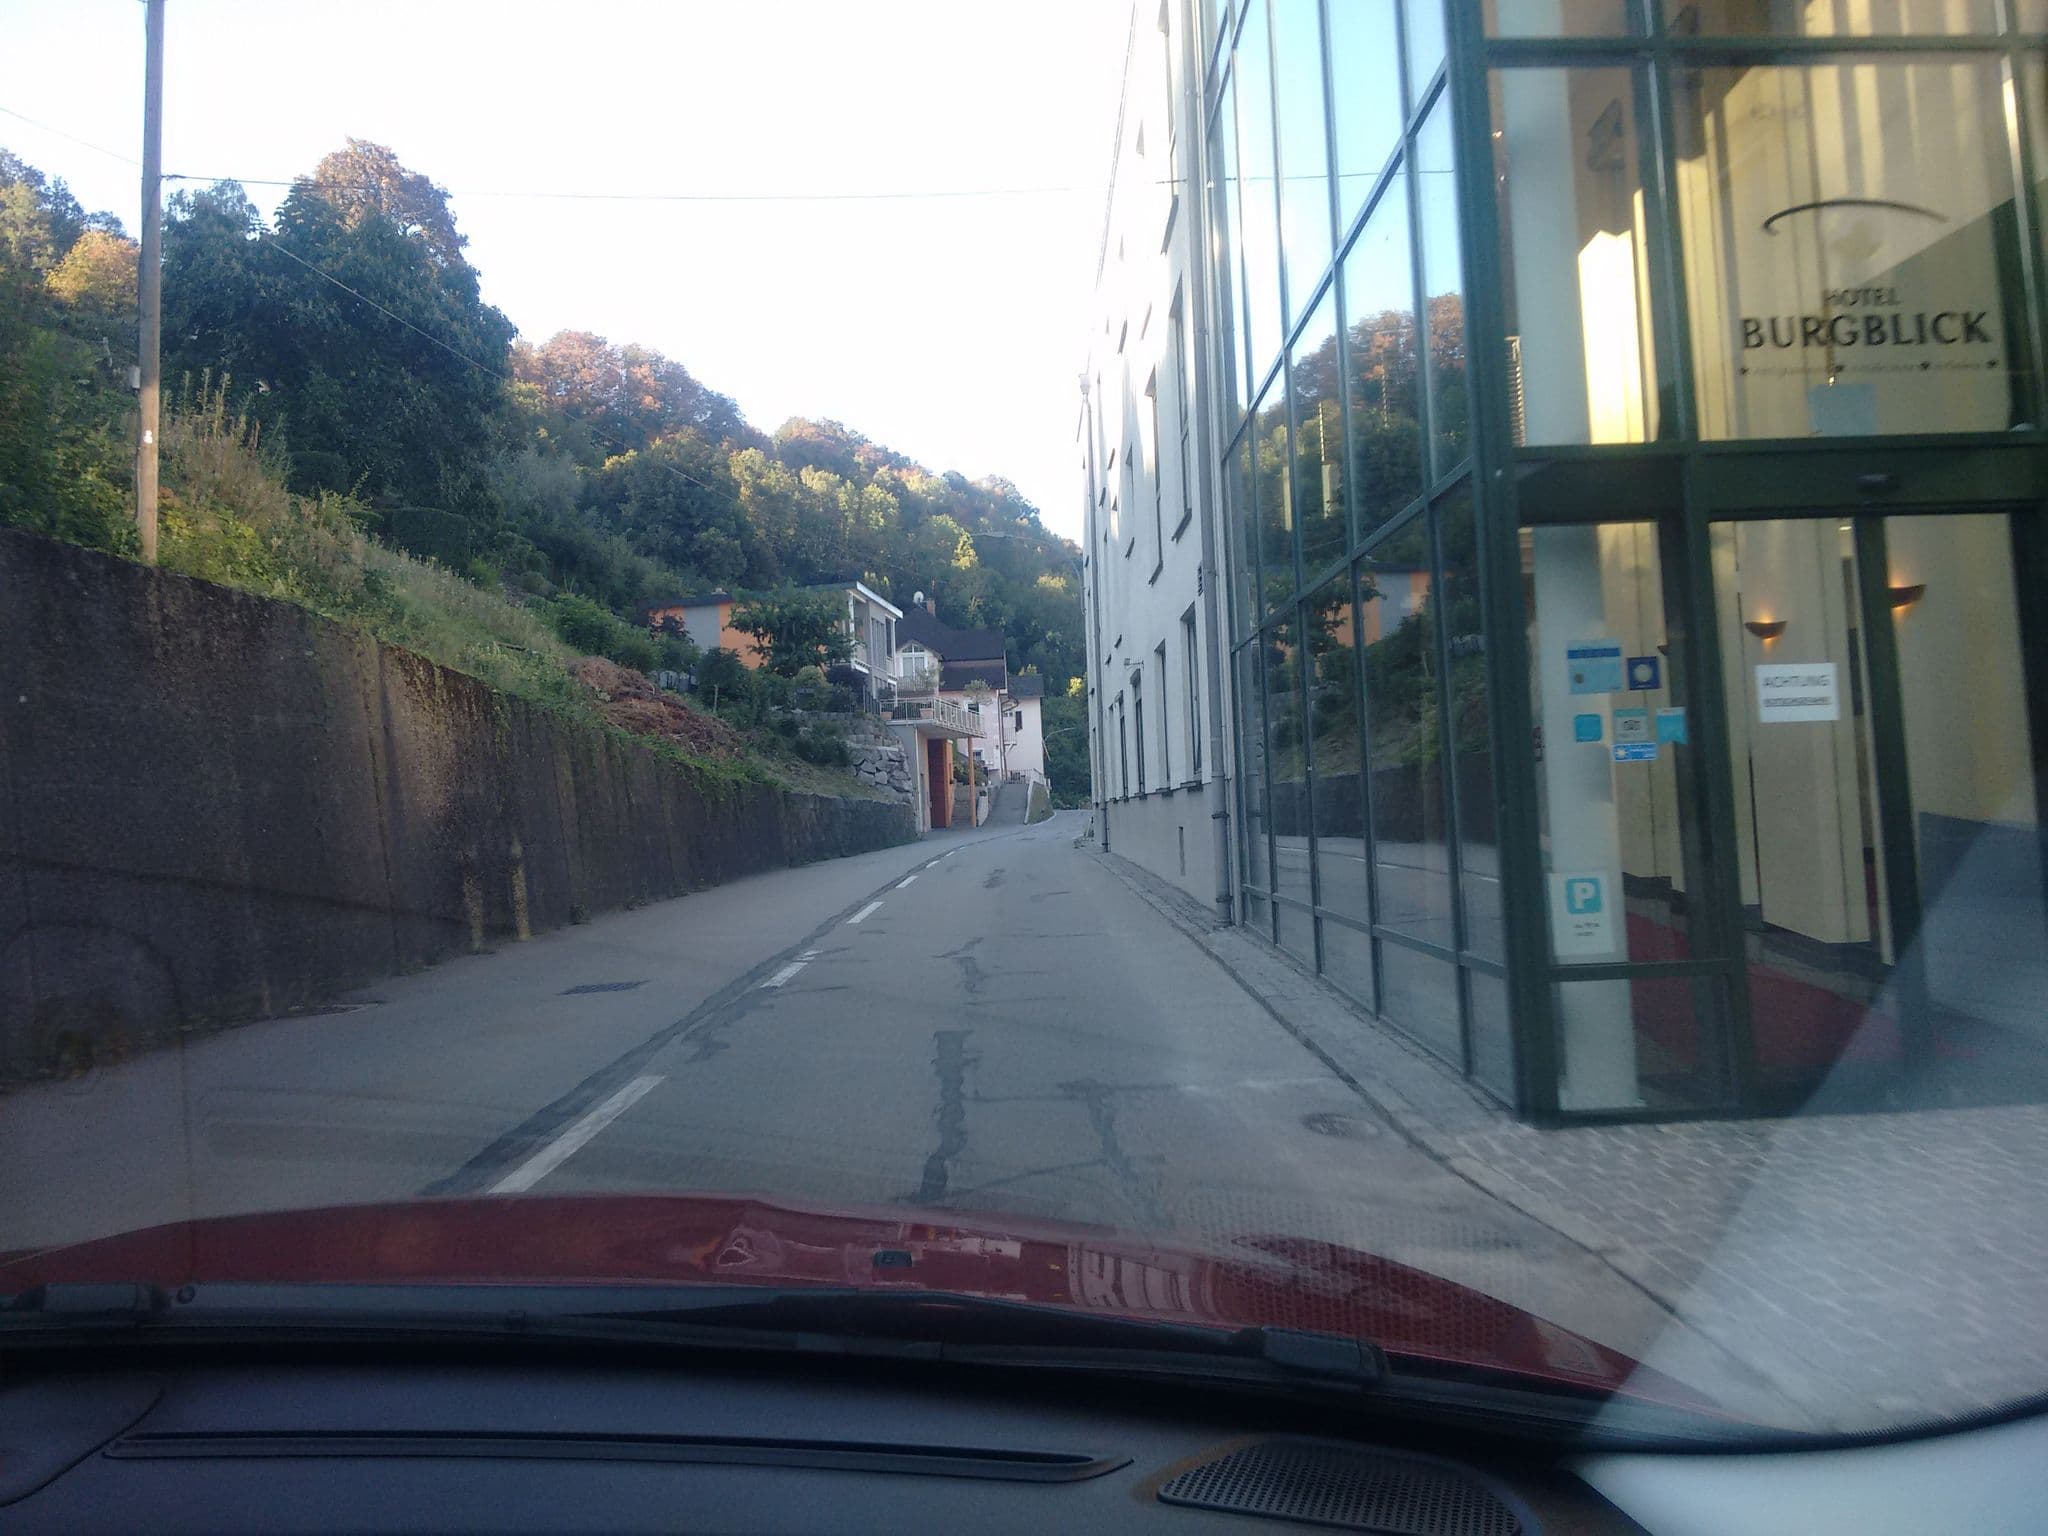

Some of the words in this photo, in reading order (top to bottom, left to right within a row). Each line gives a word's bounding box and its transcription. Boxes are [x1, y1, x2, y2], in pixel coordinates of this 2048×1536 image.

[1823, 287, 1900, 307] HOTEL
[1741, 310, 1992, 348] BURGBLICK
[1575, 882, 1595, 909] P
